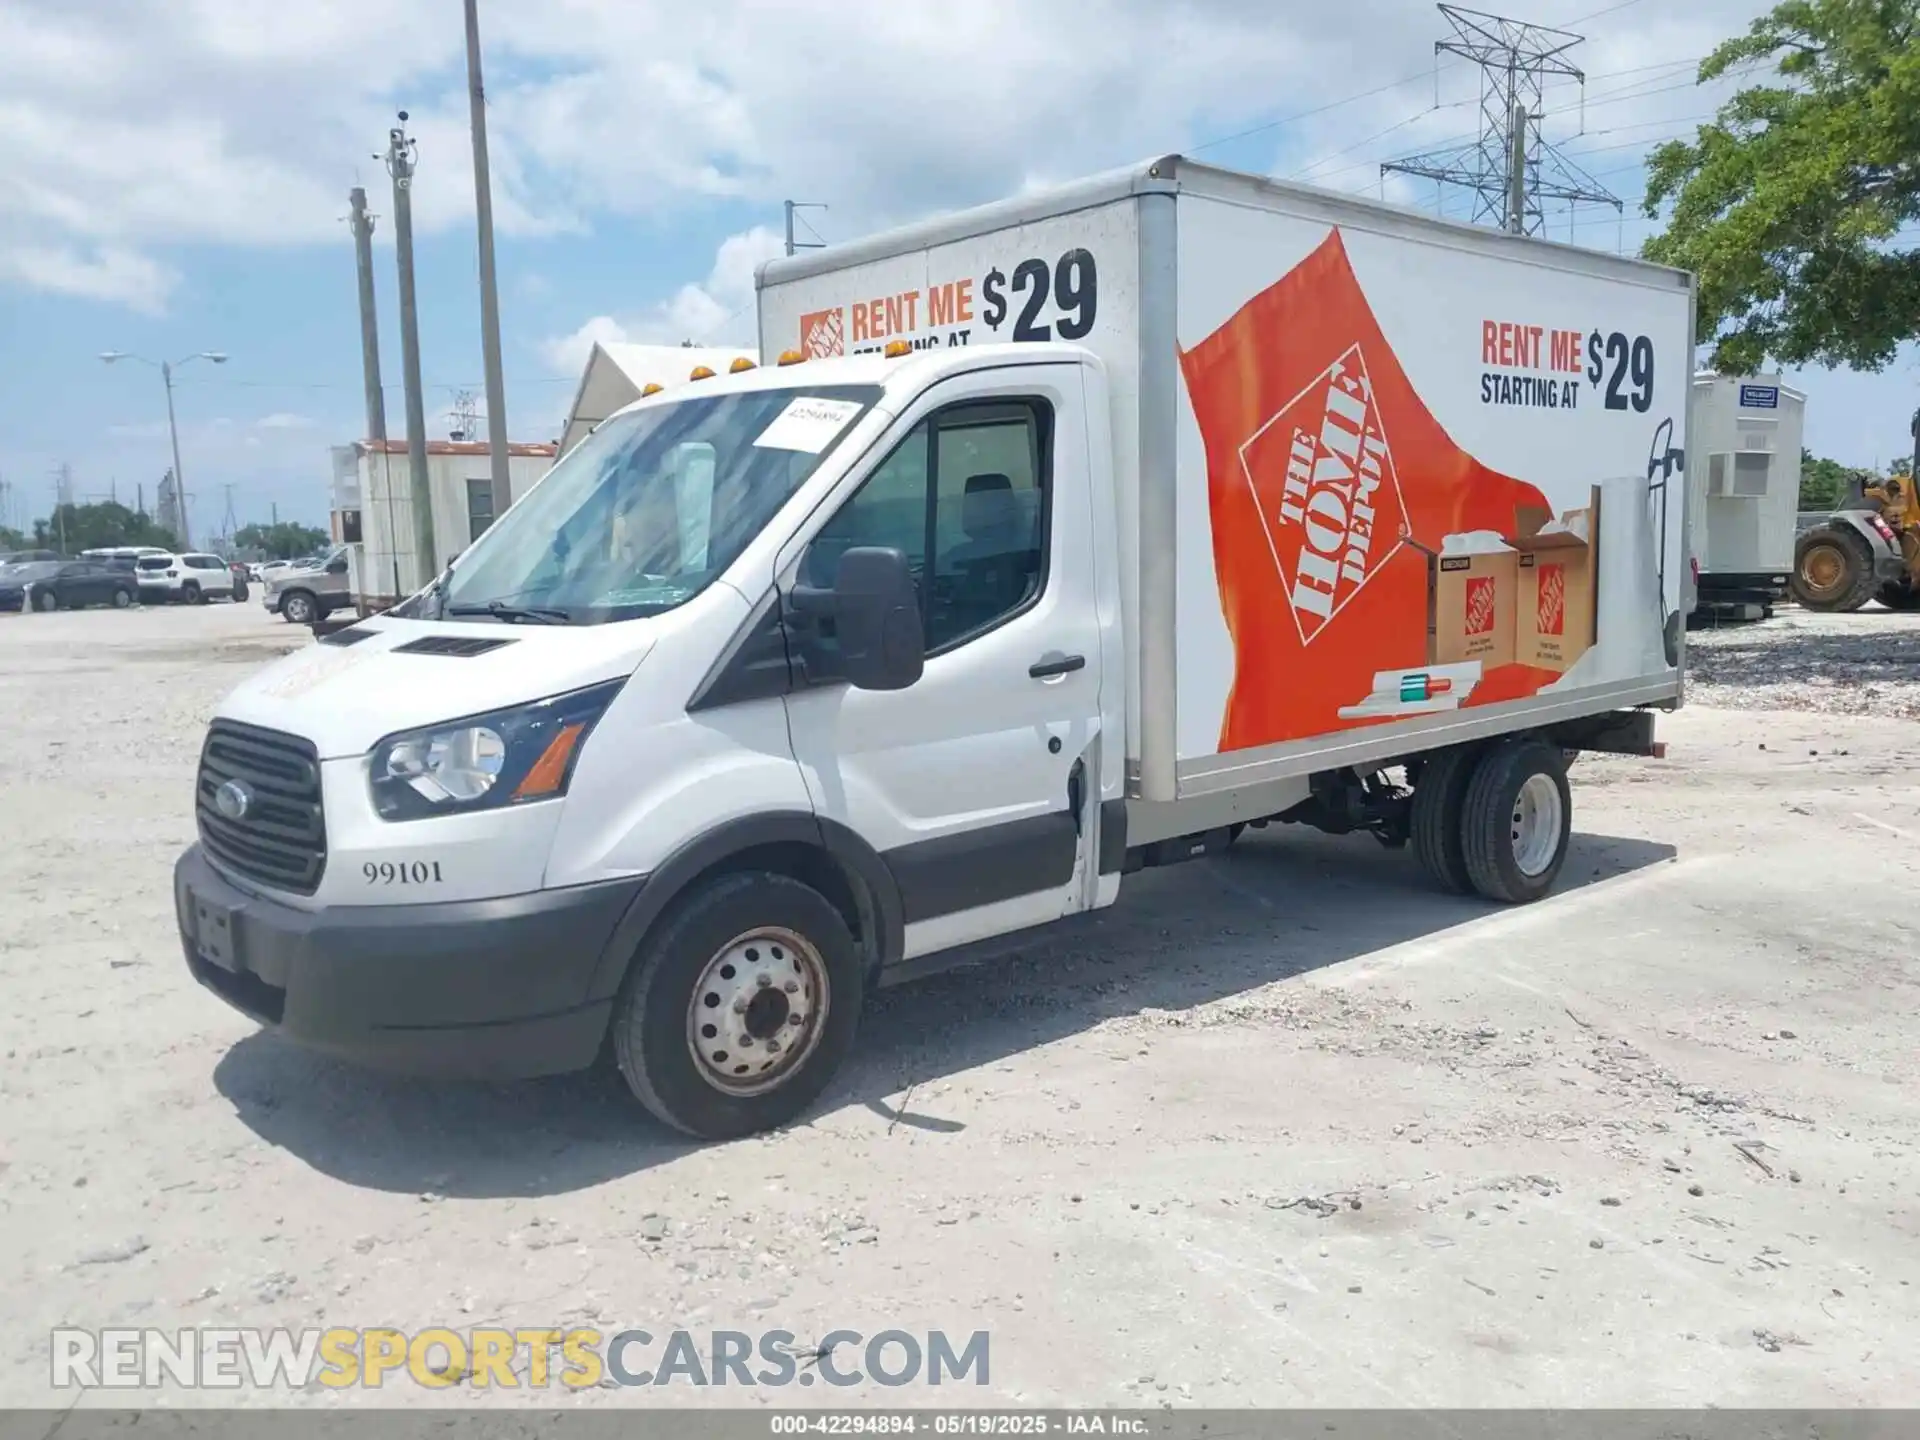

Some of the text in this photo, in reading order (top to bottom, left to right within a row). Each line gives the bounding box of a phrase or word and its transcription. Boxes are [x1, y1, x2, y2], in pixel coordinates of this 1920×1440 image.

[852, 290, 920, 342] RENT
[928, 279, 974, 328] ME
[983, 248, 1097, 342] $29
[1482, 319, 1582, 374] RENT ME
[1587, 328, 1654, 413] $29
[1481, 373, 1579, 409] STARTING AT
[1279, 426, 1317, 526] THE
[1291, 362, 1371, 620] HOME
[1341, 425, 1388, 585] DEPOT
[363, 860, 444, 885] 99101
